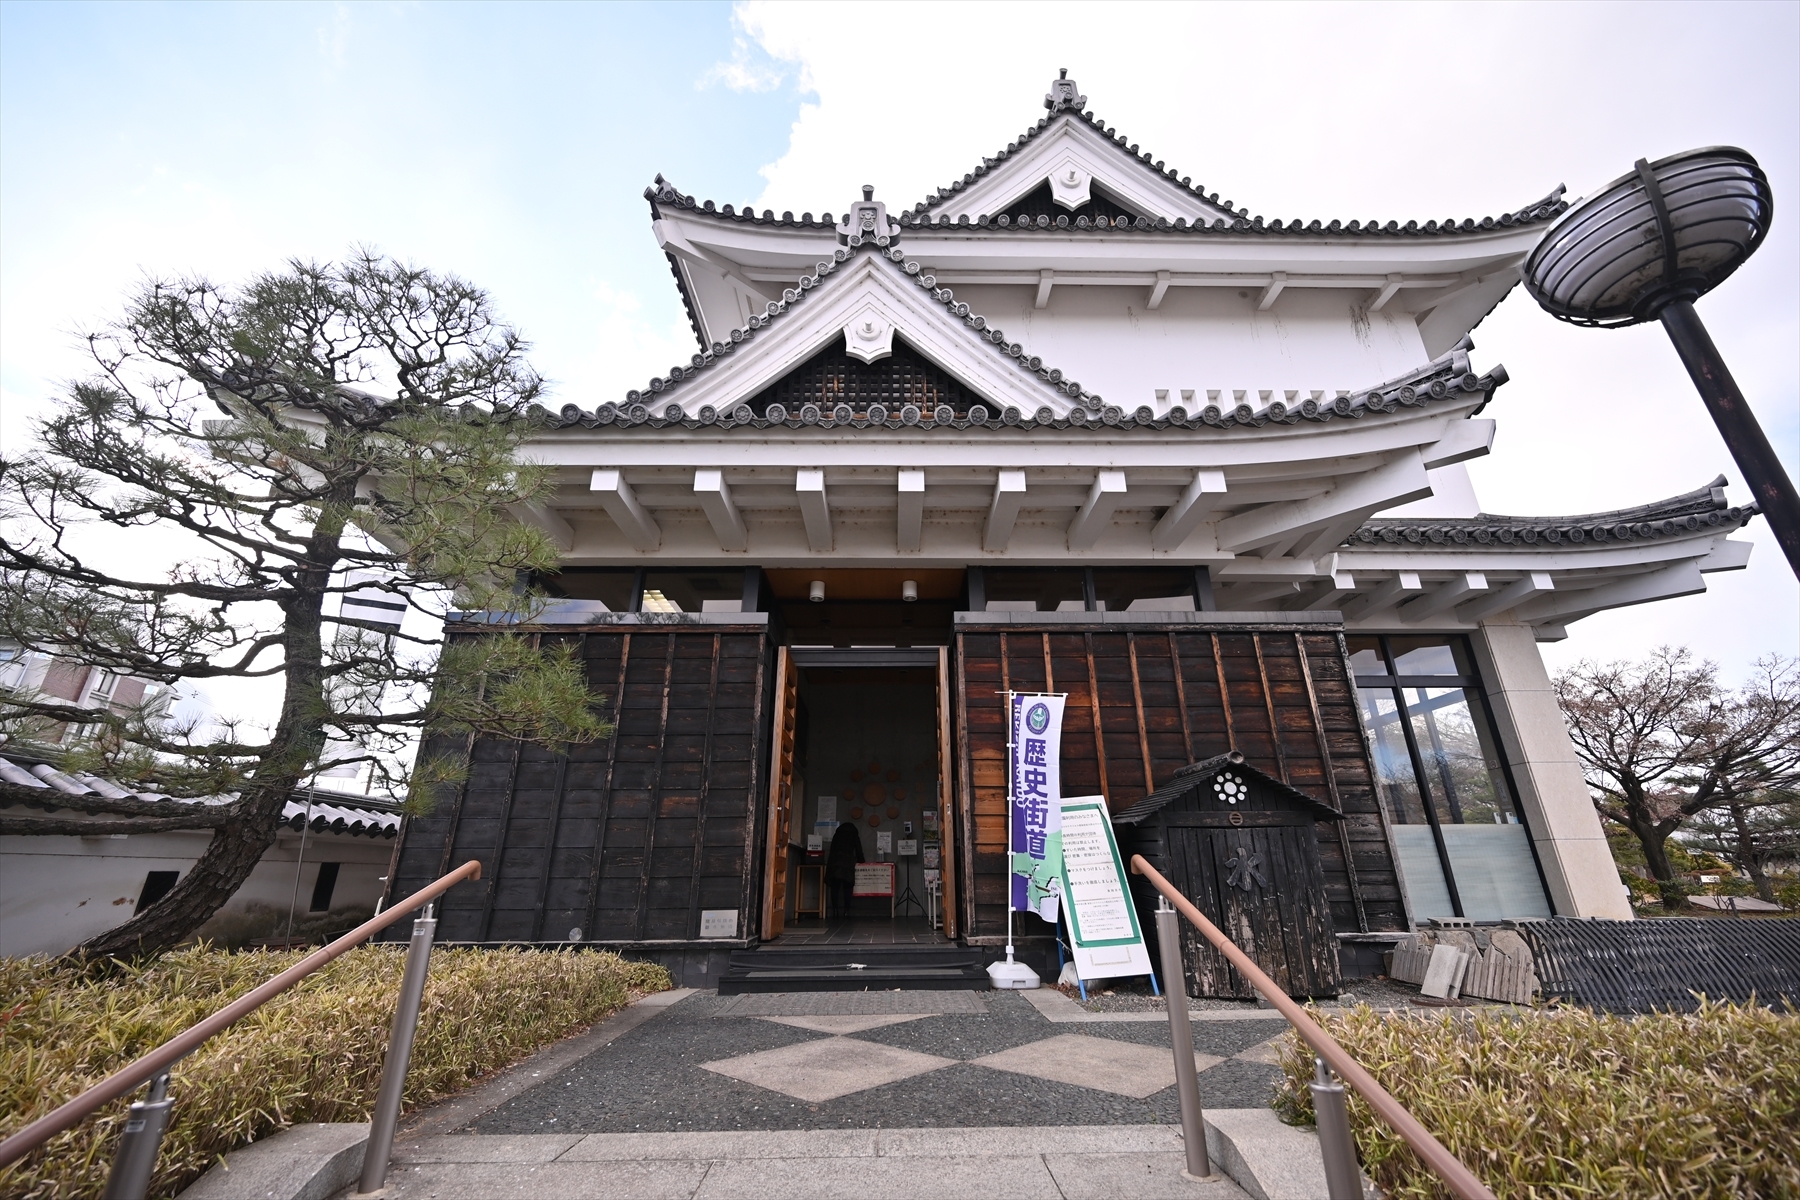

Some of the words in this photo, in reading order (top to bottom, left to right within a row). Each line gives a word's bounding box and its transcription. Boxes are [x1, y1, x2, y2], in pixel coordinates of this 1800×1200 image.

[1023, 738, 1048, 860] 歴史街道
[1224, 847, 1267, 892] 水
